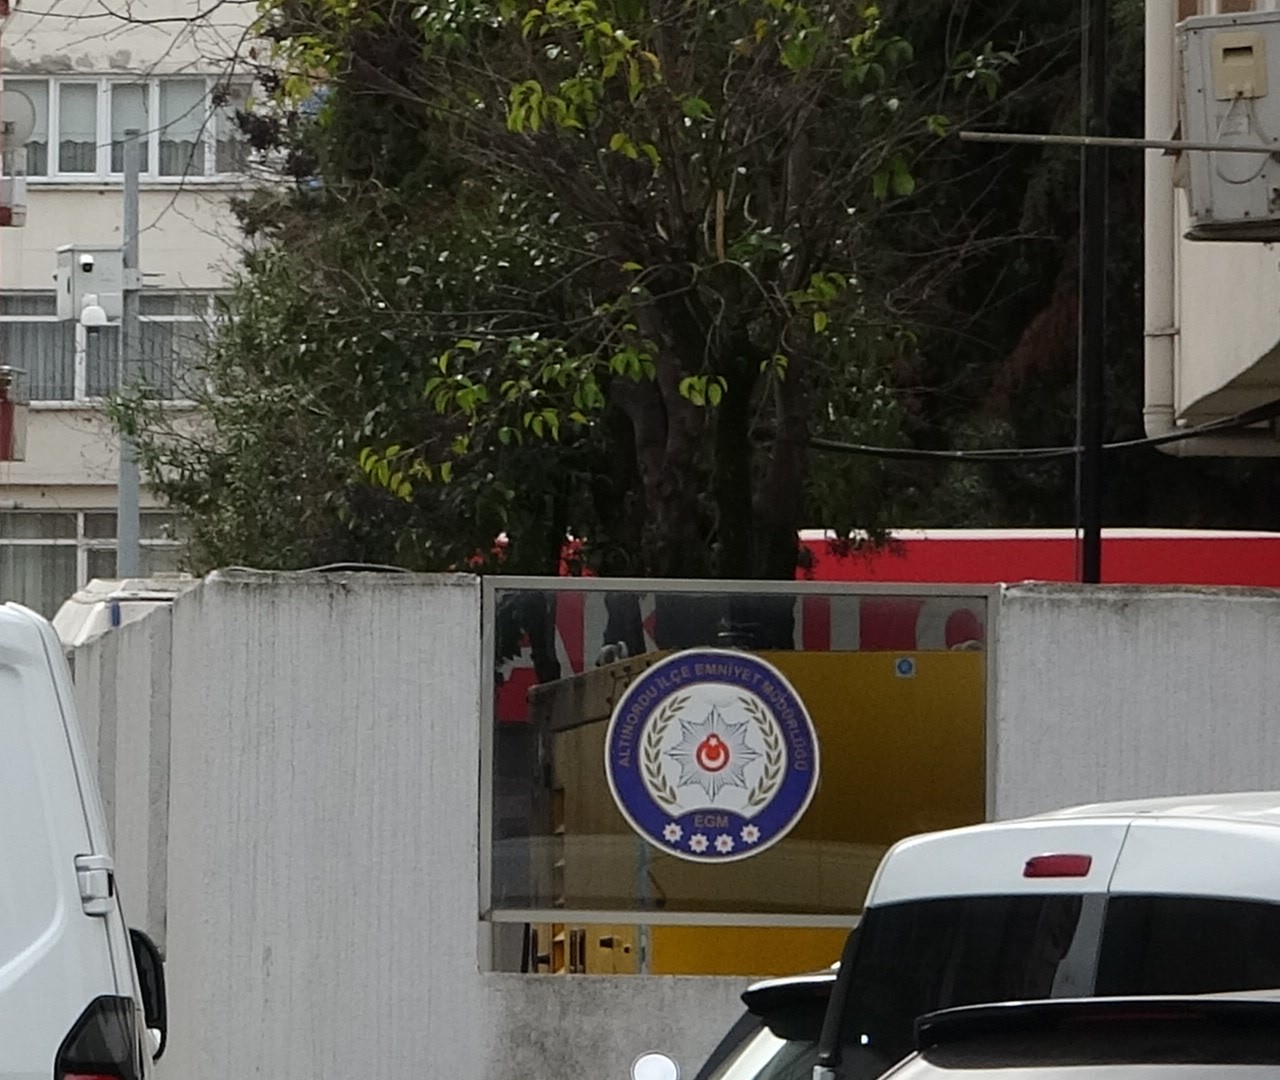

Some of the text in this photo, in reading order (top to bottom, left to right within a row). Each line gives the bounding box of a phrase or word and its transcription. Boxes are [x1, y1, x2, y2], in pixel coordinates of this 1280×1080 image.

[618, 685, 658, 767] ALTINORDU
[655, 666, 690, 690] İLÇE
[694, 663, 763, 685] EMNİYET
[693, 814, 729, 828] EGM
